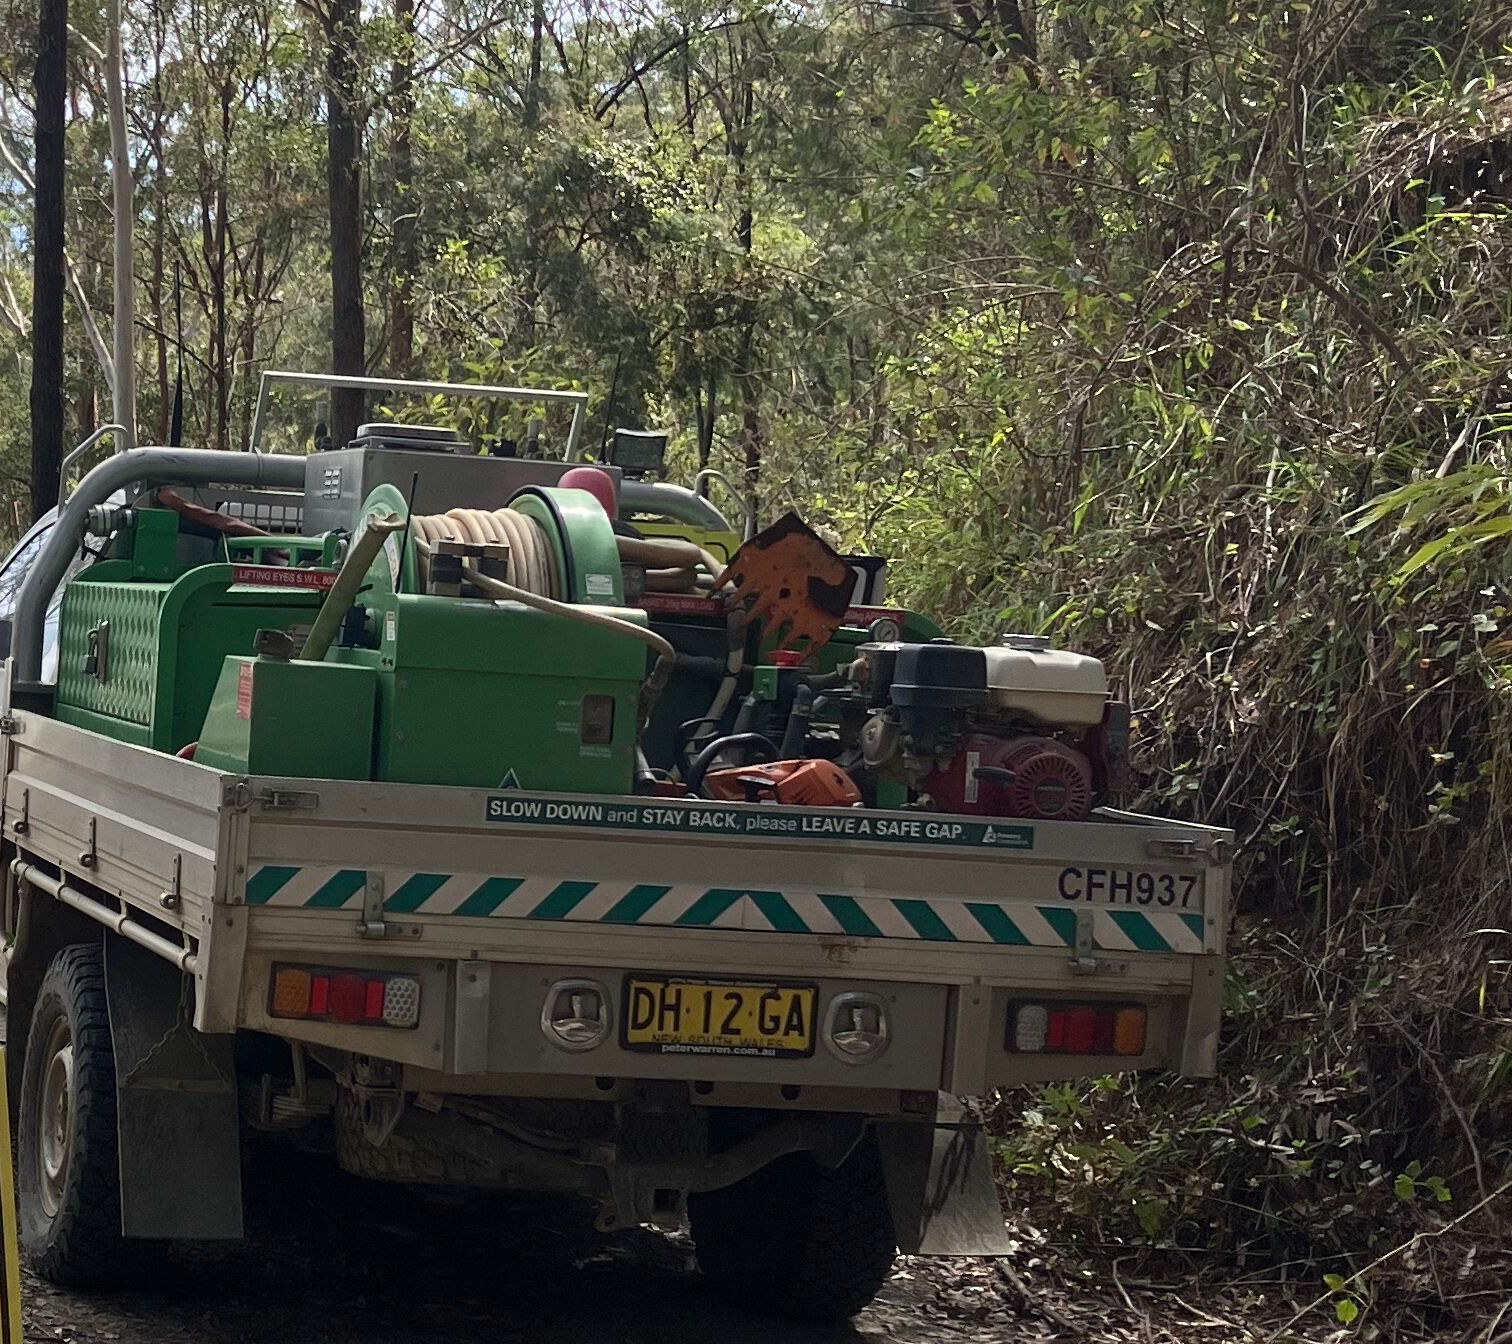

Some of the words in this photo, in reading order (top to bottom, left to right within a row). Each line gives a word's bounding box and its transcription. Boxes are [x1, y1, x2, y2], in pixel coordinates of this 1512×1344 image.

[490, 800, 542, 818] SLOW
[545, 803, 603, 821] DOWN
[607, 808, 637, 823] and
[641, 808, 684, 825] STAY
[745, 814, 797, 831] please
[801, 817, 856, 833] LEAVE
[857, 819, 871, 834] A
[875, 820, 920, 837] SAFE
[1057, 866, 1197, 907] CFH937
[661, 1044, 776, 1056] peterwarren.com.au
